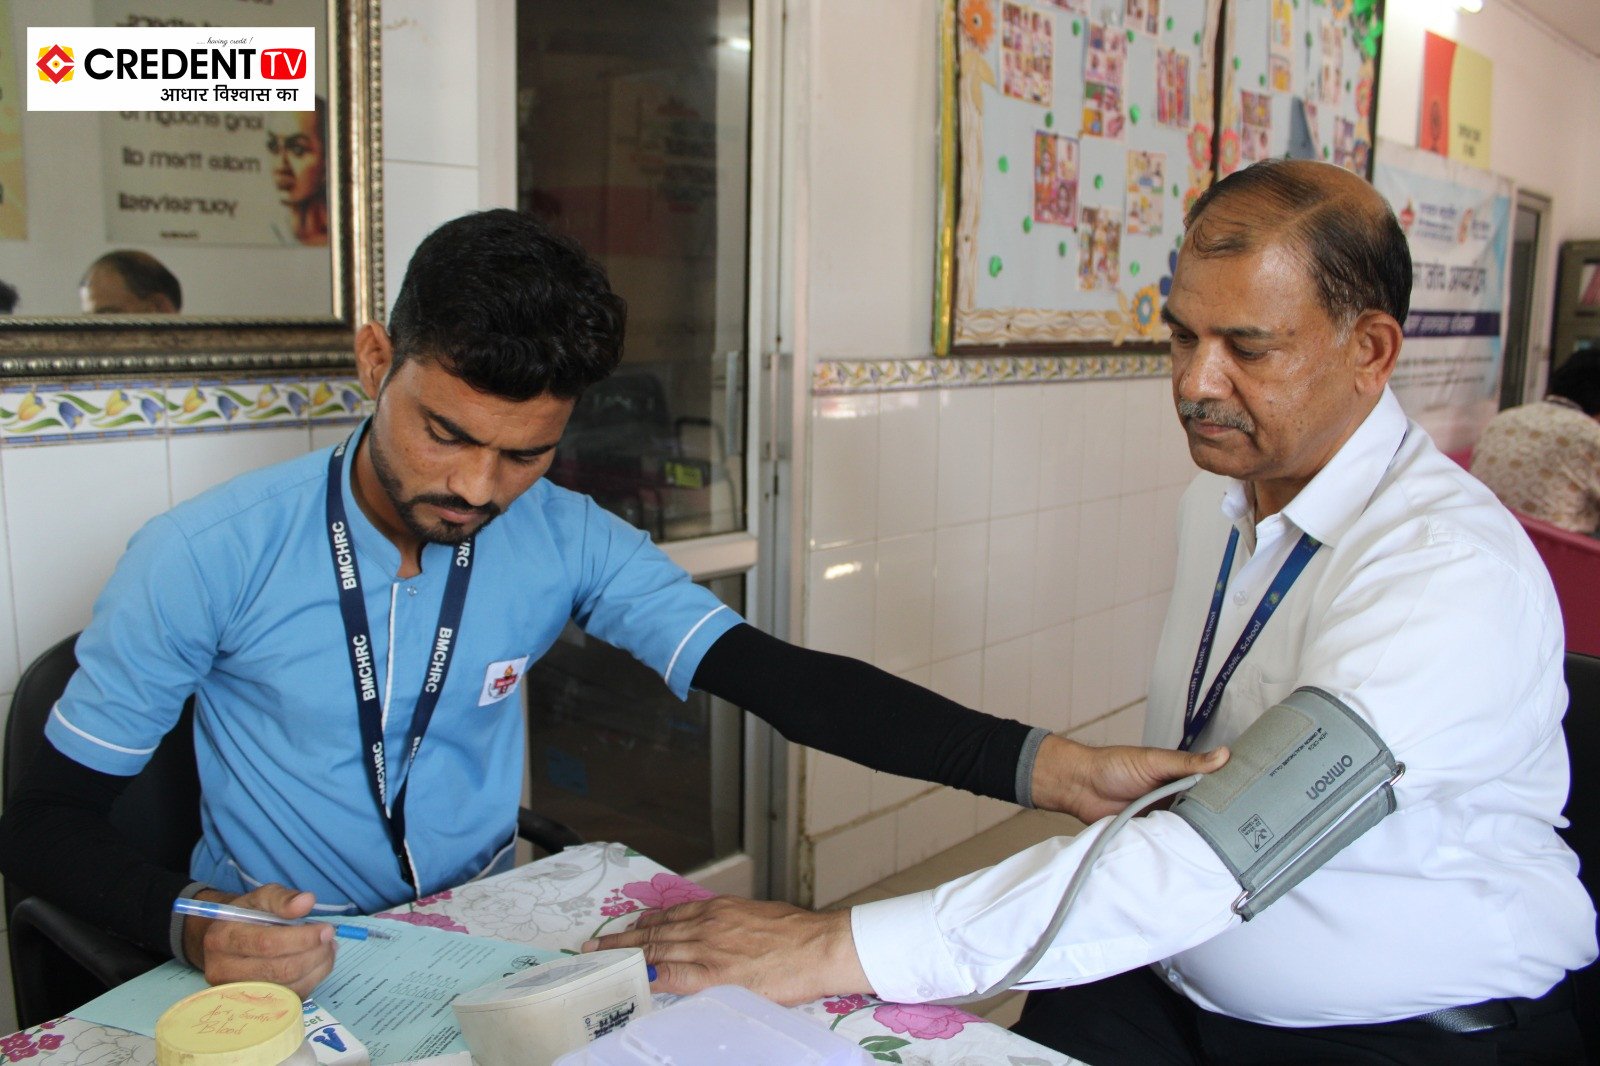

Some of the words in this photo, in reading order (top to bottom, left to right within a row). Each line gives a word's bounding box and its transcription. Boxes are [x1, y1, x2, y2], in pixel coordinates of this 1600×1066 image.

[331, 521, 357, 590] BMCHRC
[352, 633, 376, 701] BMCHRC
[426, 627, 453, 694] BMCHRC
[1194, 645, 1207, 675] Public
[1203, 611, 1216, 642] School
[1203, 681, 1224, 719] Subodh
[1222, 653, 1241, 681] Public
[1239, 620, 1262, 652] School
[373, 741, 386, 804] MCHRC
